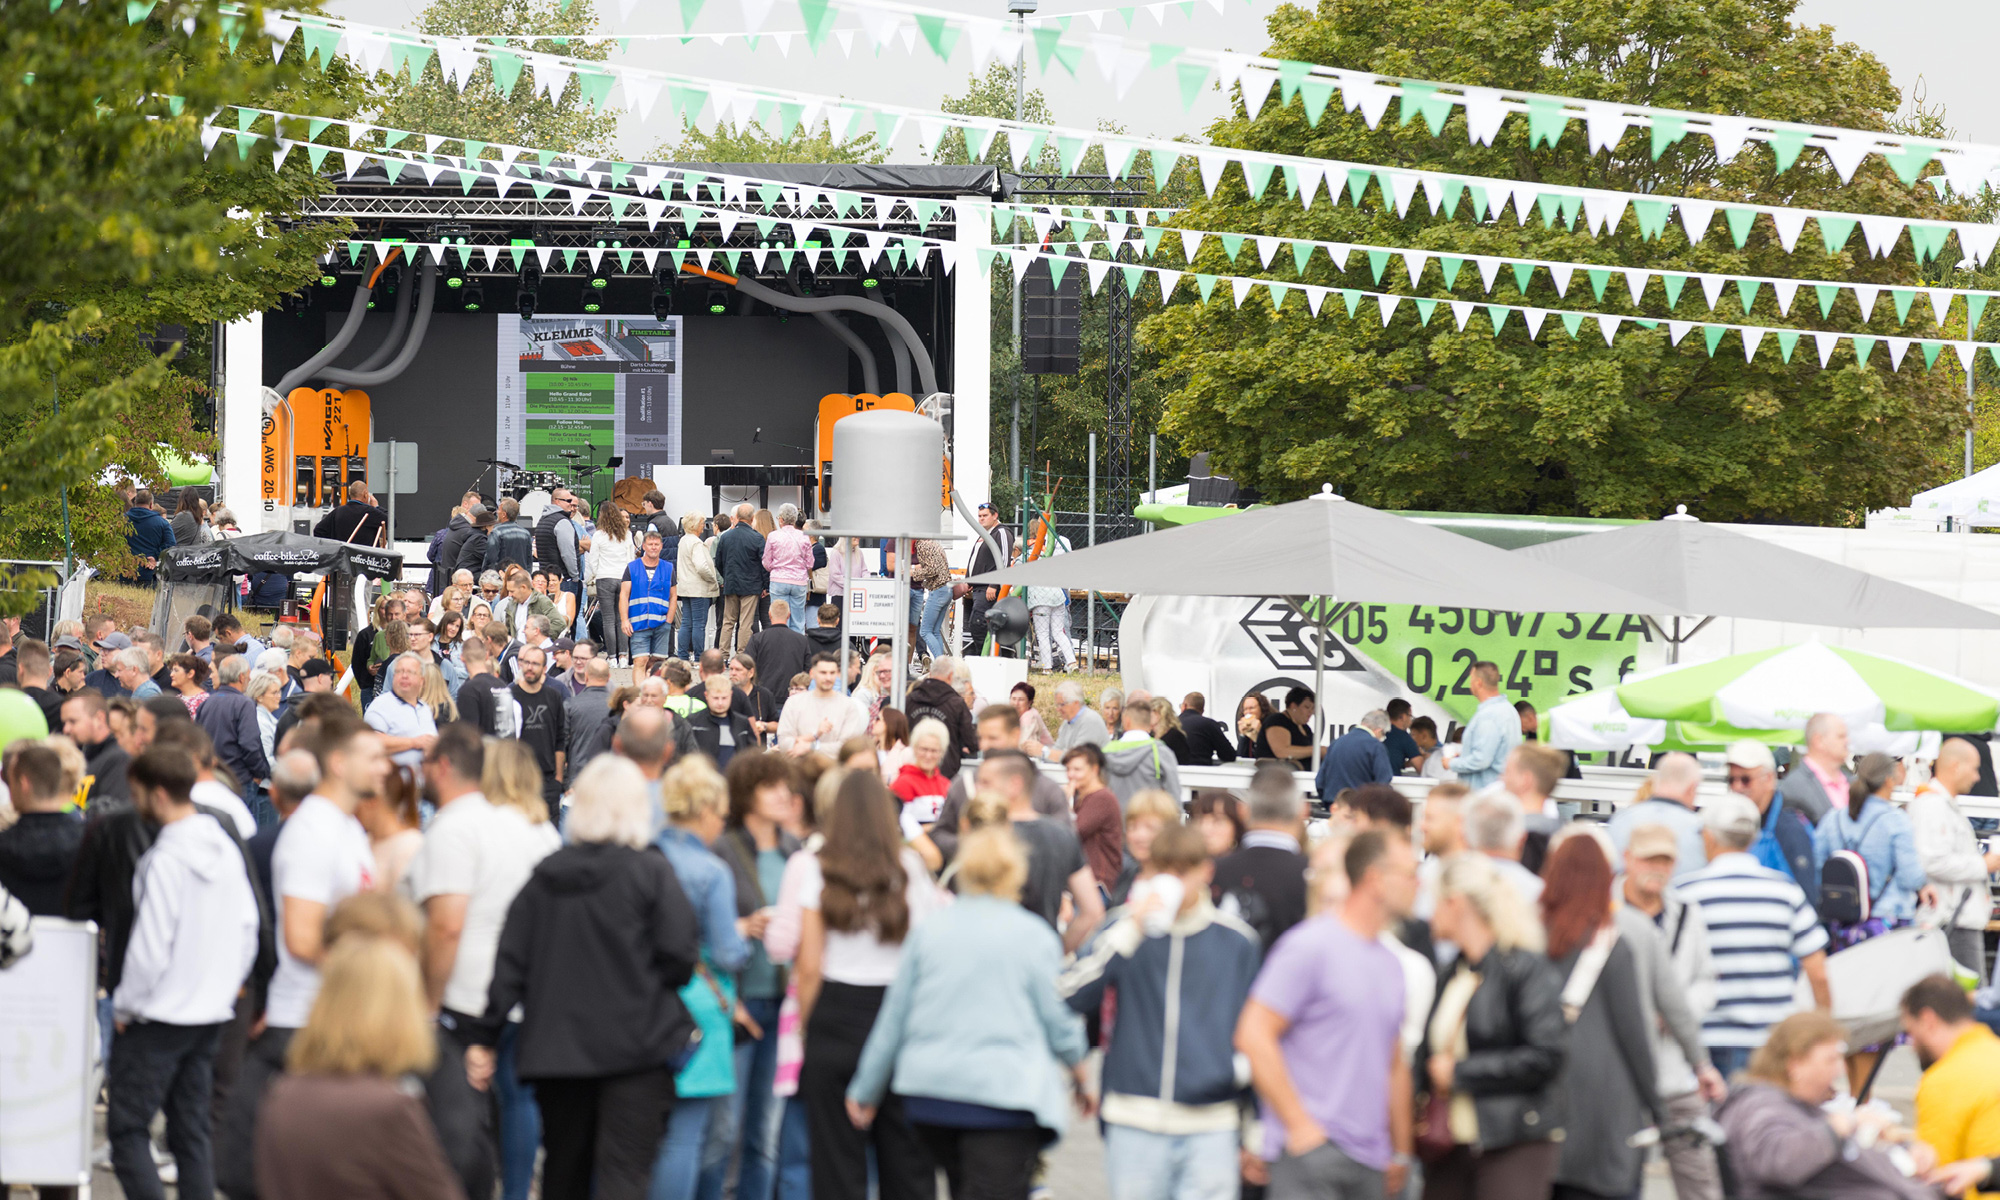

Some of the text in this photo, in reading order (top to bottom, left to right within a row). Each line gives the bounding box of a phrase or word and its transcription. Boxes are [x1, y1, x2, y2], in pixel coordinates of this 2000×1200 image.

[533, 328, 594, 342] KLEMME
[323, 393, 333, 450] WAGO
[264, 445, 274, 512] AWG 20-10
[176, 556, 206, 567] coffee-bike
[253, 550, 300, 561] coffee-bike
[350, 554, 380, 567] coffee-bike
